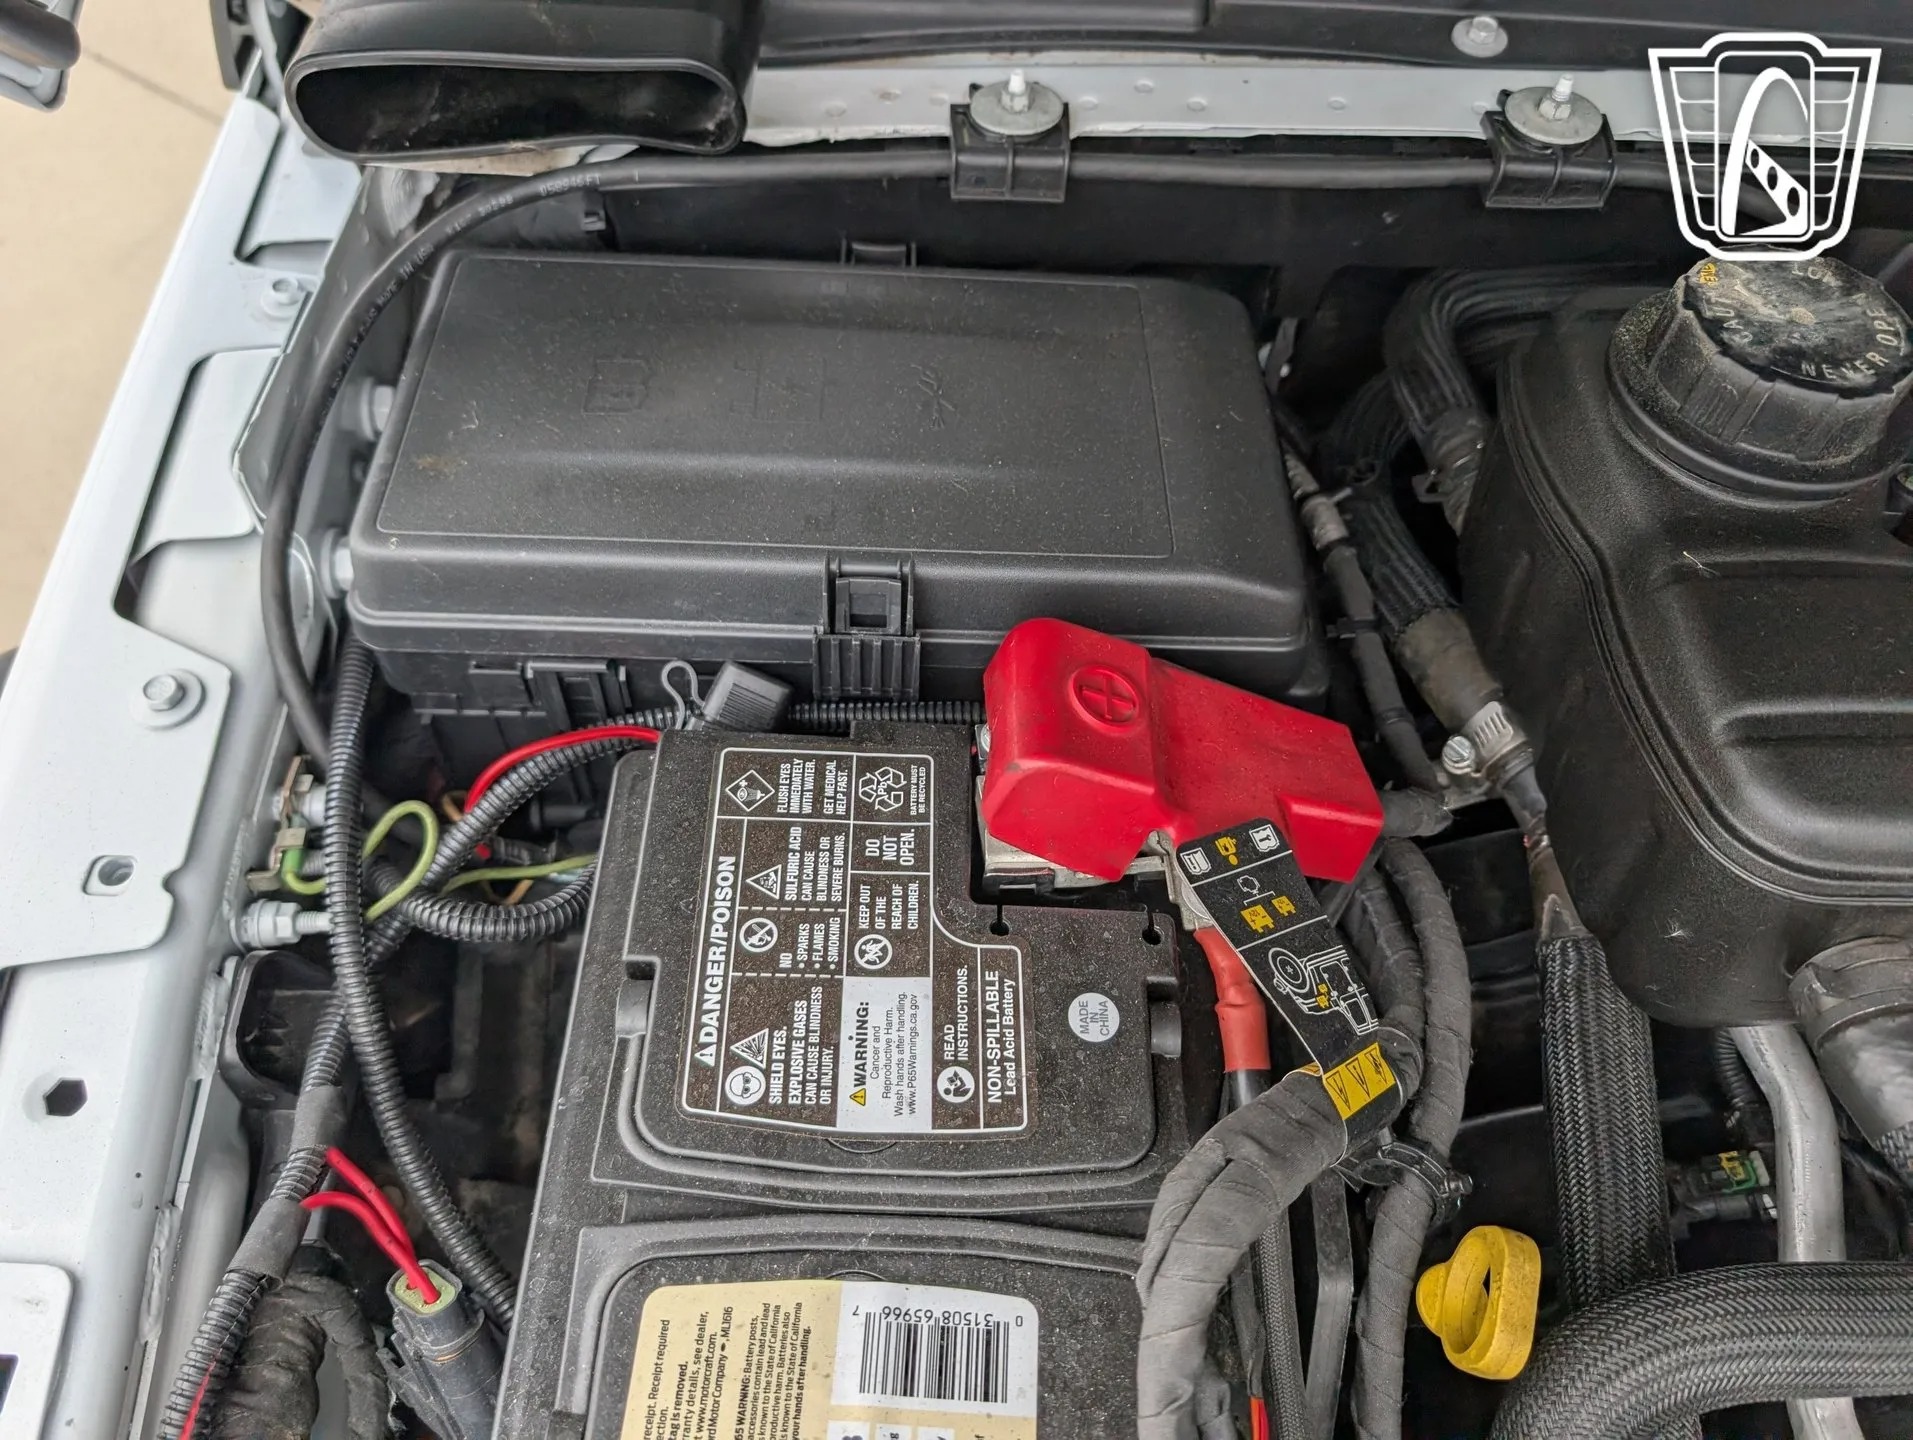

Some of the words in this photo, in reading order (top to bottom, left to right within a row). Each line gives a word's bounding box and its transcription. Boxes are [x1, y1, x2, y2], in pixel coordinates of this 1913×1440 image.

[780, 764, 790, 784] EYES
[789, 758, 803, 812] IMMEDIATELY
[804, 759, 815, 790] WATER.
[824, 760, 836, 796] MEDICAL
[837, 770, 848, 791] FAST.
[878, 782, 887, 794] Pb
[777, 786, 789, 812] FLUSH
[802, 792, 813, 814] WITH
[824, 798, 834, 814] GET
[836, 794, 846, 814] HELP
[919, 804, 925, 813] BE
[788, 827, 802, 850] ACID
[820, 837, 830, 849] OR
[833, 833, 845, 865] BURNS.
[866, 839, 880, 856] DO
[882, 835, 897, 860] NOT
[900, 829, 915, 866] OPEN.
[784, 852, 800, 900] SULFURIC
[803, 851, 814, 880] CAUSE
[816, 852, 829, 900] BLINDNESS
[802, 883, 812, 900] CAN
[831, 868, 843, 901] SEVERE
[860, 884, 870, 902] OUT
[892, 884, 902, 896] OF
[859, 905, 870, 928] KEEP
[875, 896, 886, 914] THE
[891, 898, 902, 929] REACH
[908, 880, 919, 929] CHILDREN.
[875, 916, 886, 929] OF
[700, 856, 735, 1043] DANGER/POISON
[797, 924, 810, 960] SPARKS
[812, 924, 825, 960] FLAMES
[828, 918, 840, 962] SMOKING
[779, 953, 792, 968] NO
[809, 986, 822, 1042] BLINDNESS
[896, 992, 907, 1032] handling.
[957, 965, 968, 1060] INSTRUCTIONS.
[1002, 979, 1015, 1025] Battery
[793, 1000, 807, 1036] GASES
[884, 1008, 893, 1034] Harm.
[1078, 1000, 1089, 1034] MADE
[1089, 1012, 1098, 1023] IN
[1098, 1000, 1110, 1036] CHINA
[772, 1026, 787, 1059] EYES.
[854, 1002, 869, 1087] WARNING:
[872, 1026, 880, 1043] and
[896, 1035, 905, 1054] after
[944, 1025, 954, 1060] READ
[985, 970, 1002, 1103] NON-SPILLABLE
[1003, 1029, 1015, 1058] Acid
[807, 1046, 819, 1080] CAUSE
[821, 1046, 834, 1086] INJURY.
[870, 1046, 880, 1079] Cancer
[882, 1038, 893, 1098] Reproductive
[908, 994, 919, 1114] www.P65Warnings.ca.gov
[769, 1063, 782, 1104] SHIELD
[788, 1040, 804, 1104] EXPLOSIVE
[895, 1058, 904, 1086] hands
[1004, 1062, 1016, 1095] Lead
[805, 1083, 817, 1104] CAN
[820, 1089, 831, 1104] OR
[894, 1090, 904, 1116] Wash
[760, 1303, 770, 1320] lead
[770, 1305, 781, 1344] California
[781, 1312, 790, 1329] also
[792, 1302, 802, 1341] California
[852, 1305, 860, 1315] 7
[882, 1306, 934, 1323] 65966
[942, 1310, 994, 1327] 31508
[1015, 1316, 1023, 1326] 0
[695, 1312, 709, 1345] dealer,
[748, 1316, 759, 1340] posts,
[760, 1322, 768, 1338] and
[648, 1362, 663, 1399] Receipt
[656, 1320, 670, 1360] required
[693, 1348, 702, 1364] see
[743, 1342, 756, 1373] Battery
[756, 1339, 766, 1356] lead
[766, 1345, 776, 1354] of
[776, 1330, 789, 1368] Batteries
[789, 1343, 798, 1352] of
[798, 1326, 811, 1366] handling.
[712, 1354, 727, 1397] Company
[753, 1359, 763, 1390] contain
[765, 1356, 775, 1378] State
[787, 1353, 797, 1376] State
[796, 1368, 806, 1390] after
[673, 1361, 688, 1410] removed.
[686, 1368, 701, 1406] details,
[696, 1332, 717, 1433] www.motorcraft.com.
[762, 1380, 772, 1394] the
[773, 1370, 784, 1394] harm.
[785, 1377, 794, 1390] the
[736, 1374, 751, 1426] WARNING:
[762, 1396, 770, 1404] to
[784, 1393, 792, 1401] to
[792, 1393, 804, 1420] hands
[670, 1412, 680, 1421] is
[708, 1398, 720, 1427] Motor
[746, 1391, 760, 1440] accessories
[758, 1407, 769, 1436] known
[780, 1404, 791, 1432] known
